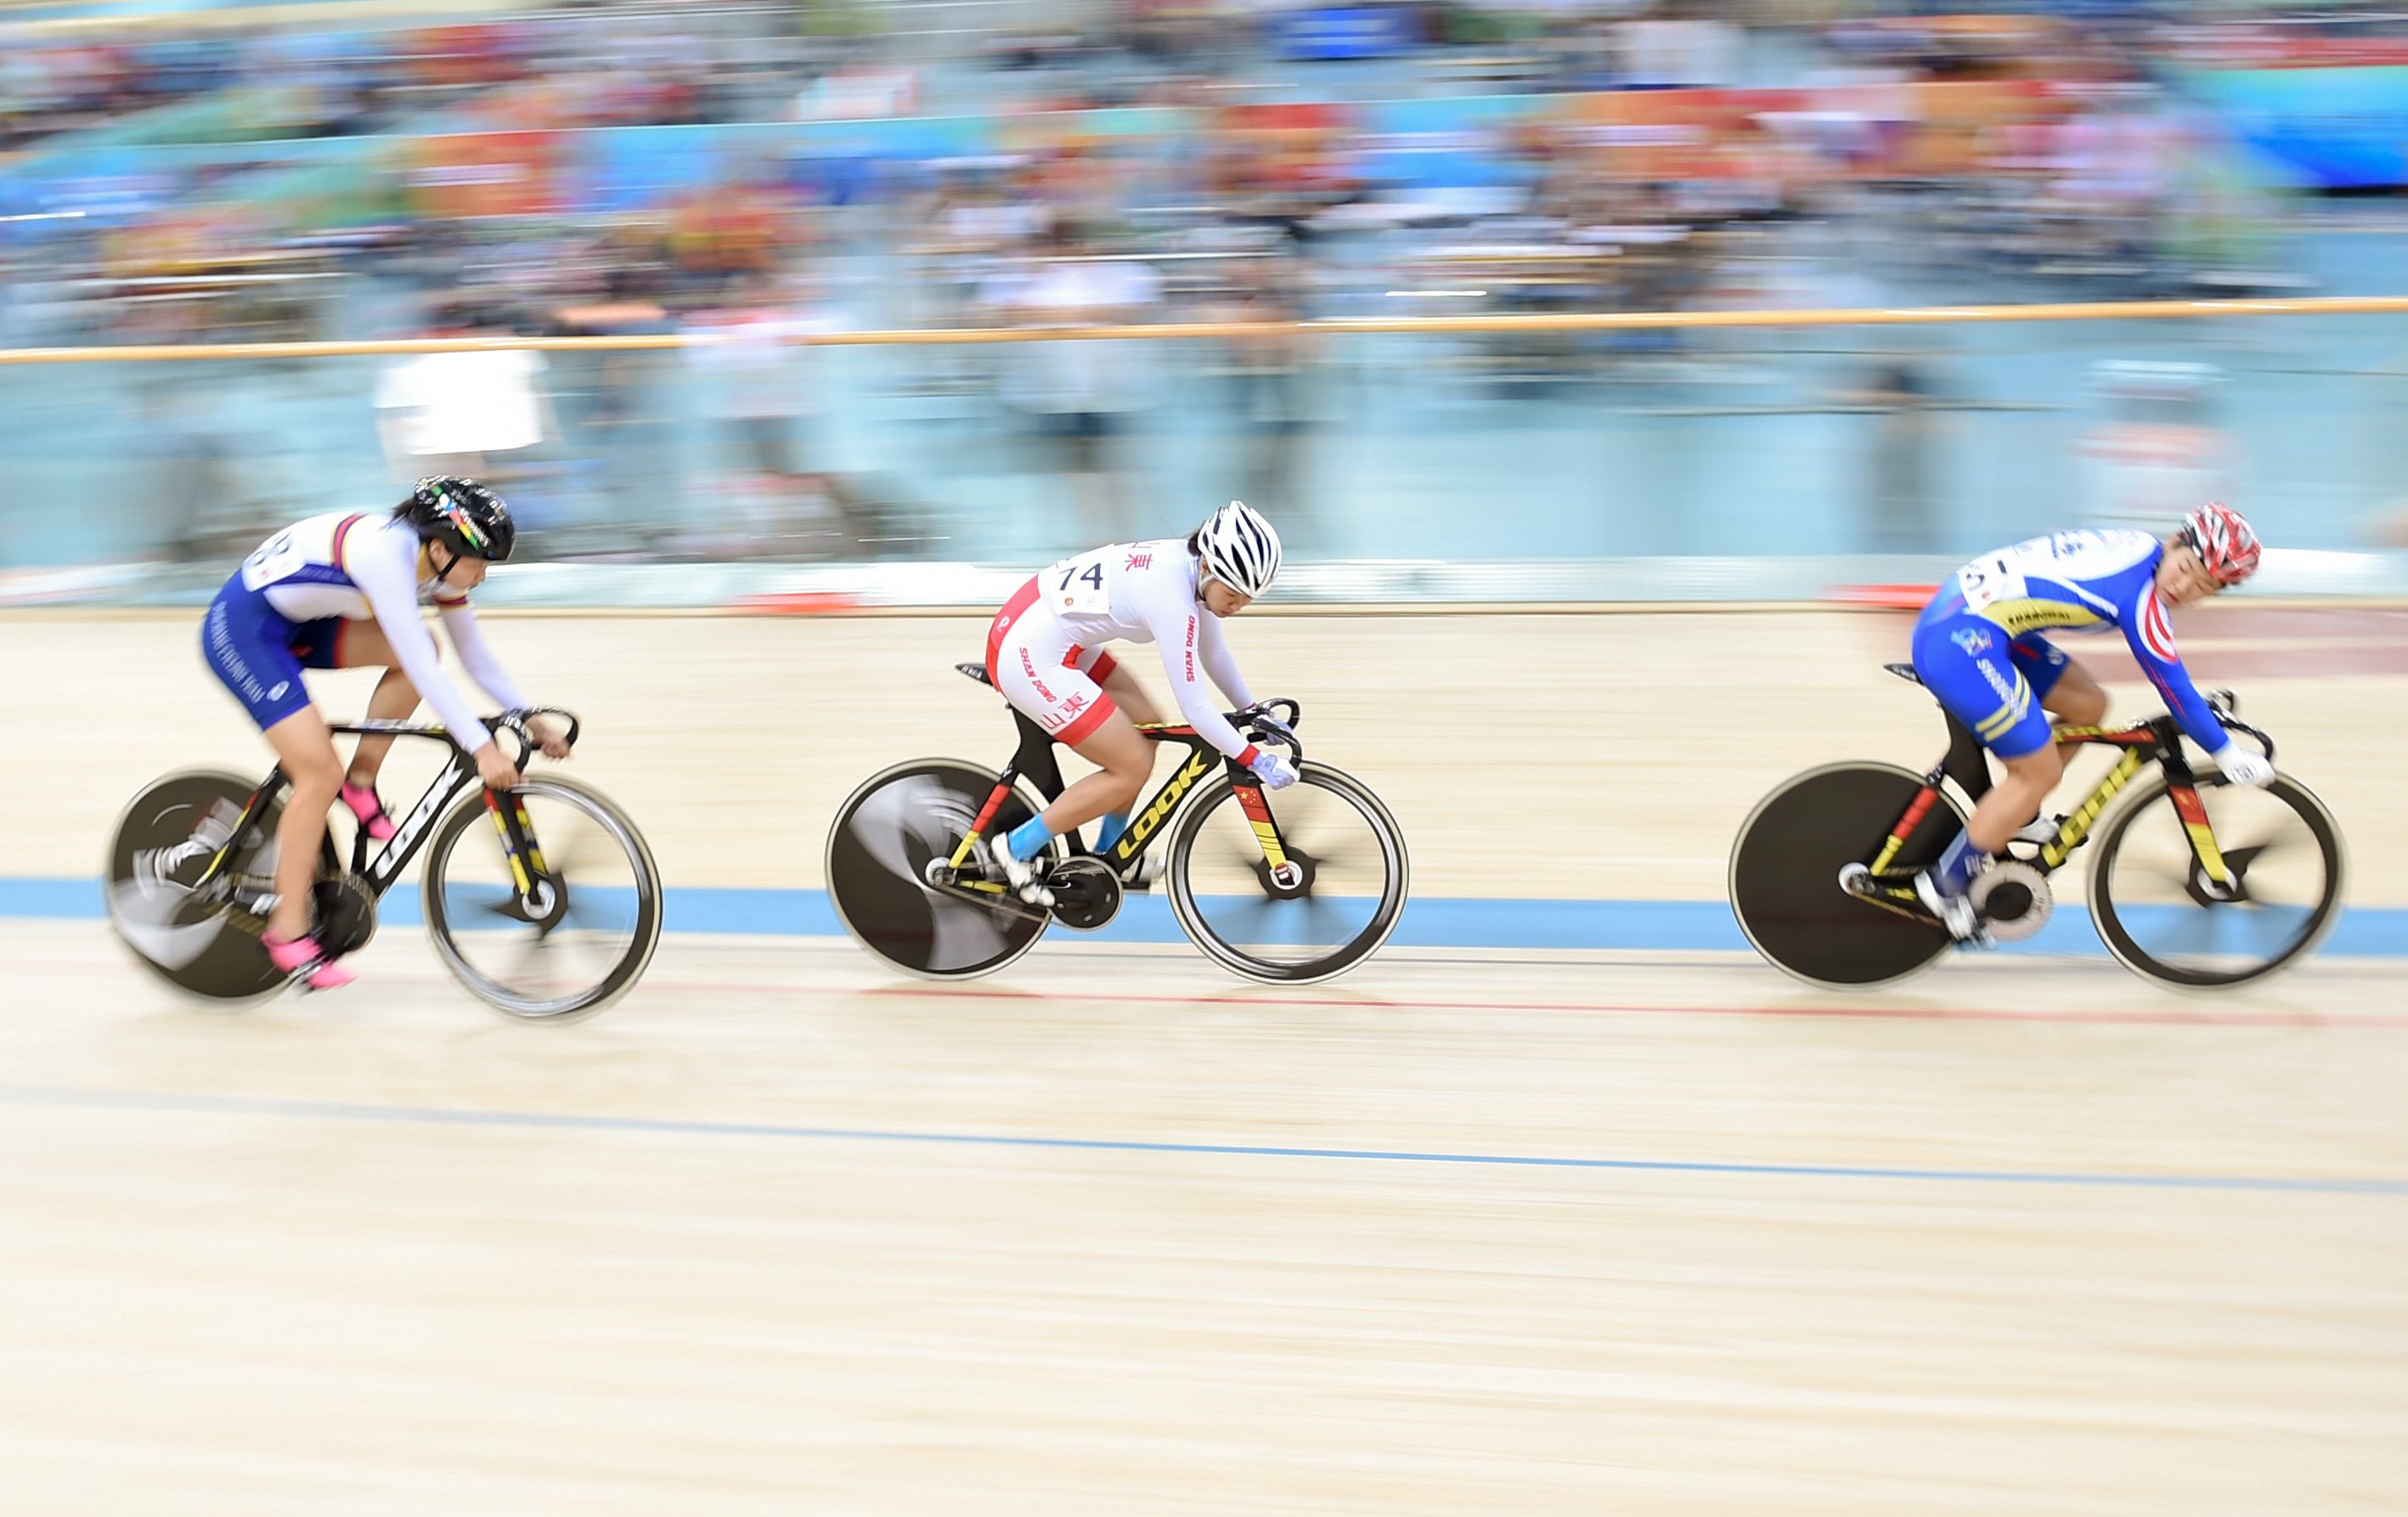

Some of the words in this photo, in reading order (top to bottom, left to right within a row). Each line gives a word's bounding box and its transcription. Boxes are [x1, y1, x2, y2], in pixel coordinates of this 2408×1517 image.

[1058, 562, 1103, 591] 74
[1186, 615, 1195, 647] DONG
[1019, 647, 1037, 677] SHAN
[1032, 679, 1057, 702] DONG
[1185, 651, 1195, 682] SHAN
[375, 753, 464, 880] LOOK
[1117, 750, 1207, 860] LOOK
[2042, 746, 2143, 867] LOOK
